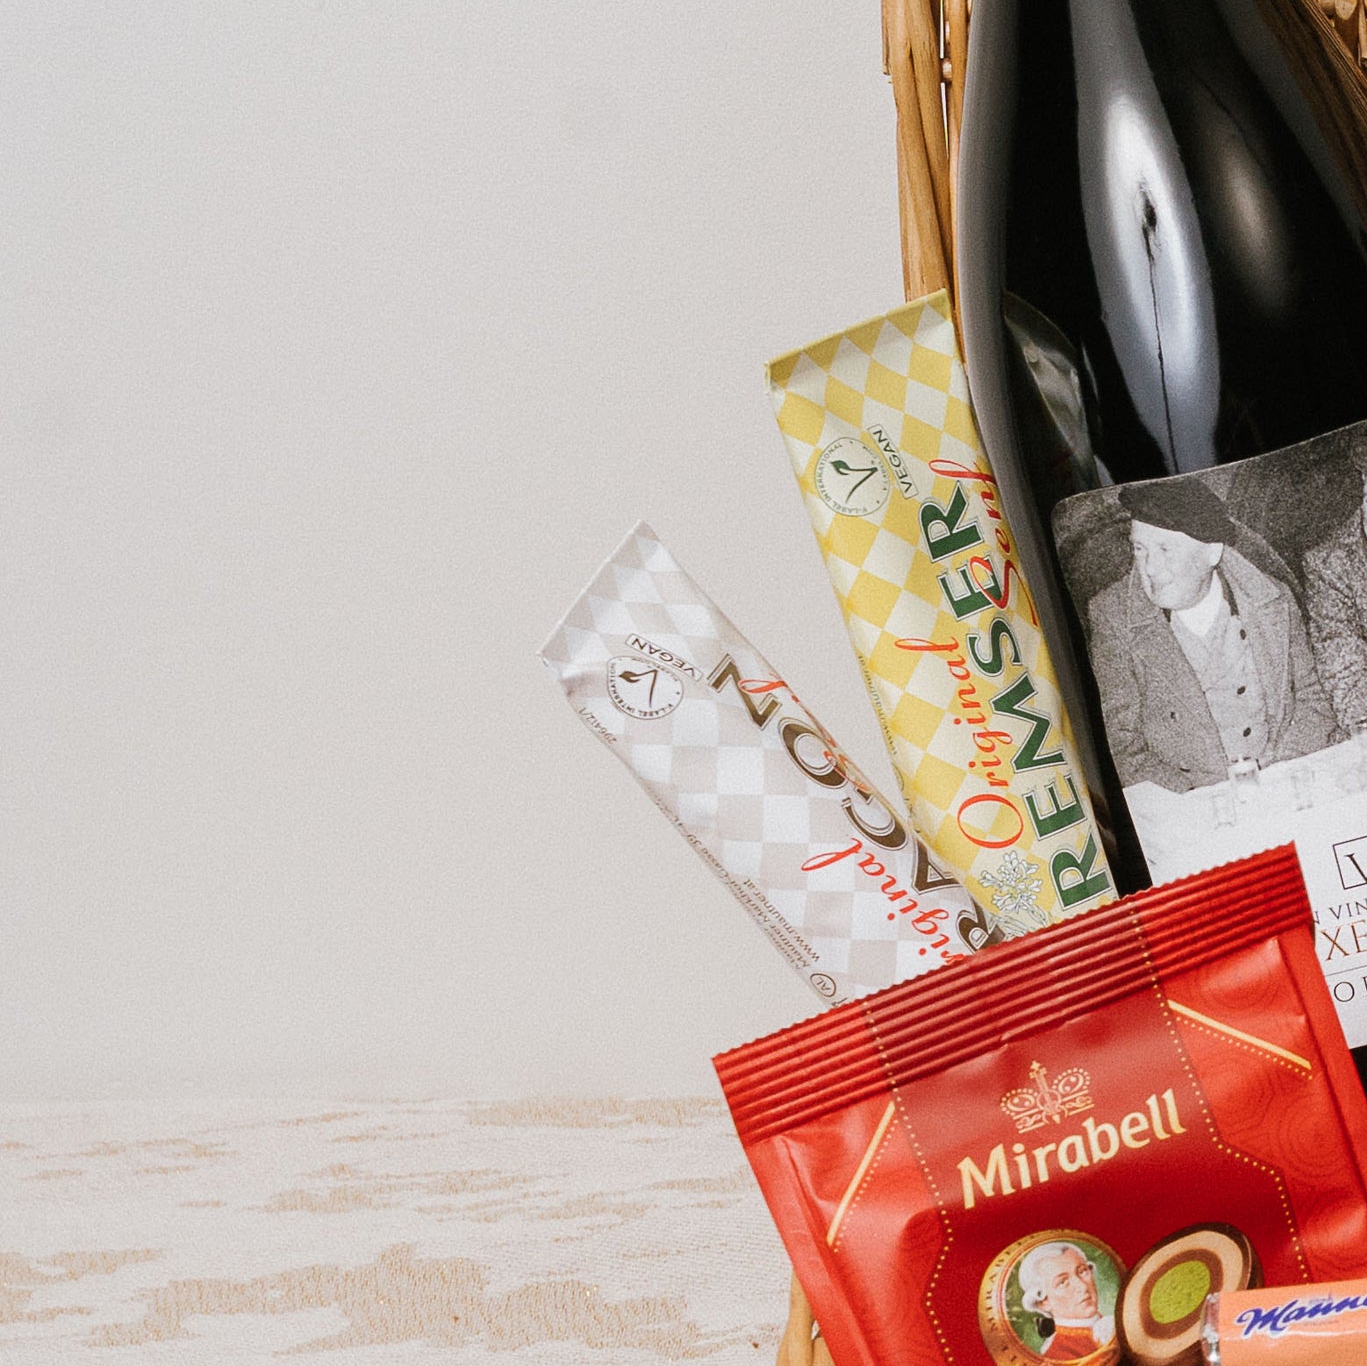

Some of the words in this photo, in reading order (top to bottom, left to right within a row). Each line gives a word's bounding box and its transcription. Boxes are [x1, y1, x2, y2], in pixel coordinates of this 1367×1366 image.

[873, 429, 913, 495] VEGAN
[631, 637, 696, 678] VEGAN
[918, 479, 1114, 911] REMSER
[706, 653, 1005, 952] RAGON
[895, 636, 1024, 849] Original
[743, 878, 820, 962] www.mautner.at
[800, 837, 968, 965] riginal
[957, 1088, 1187, 1209] Mirabell
